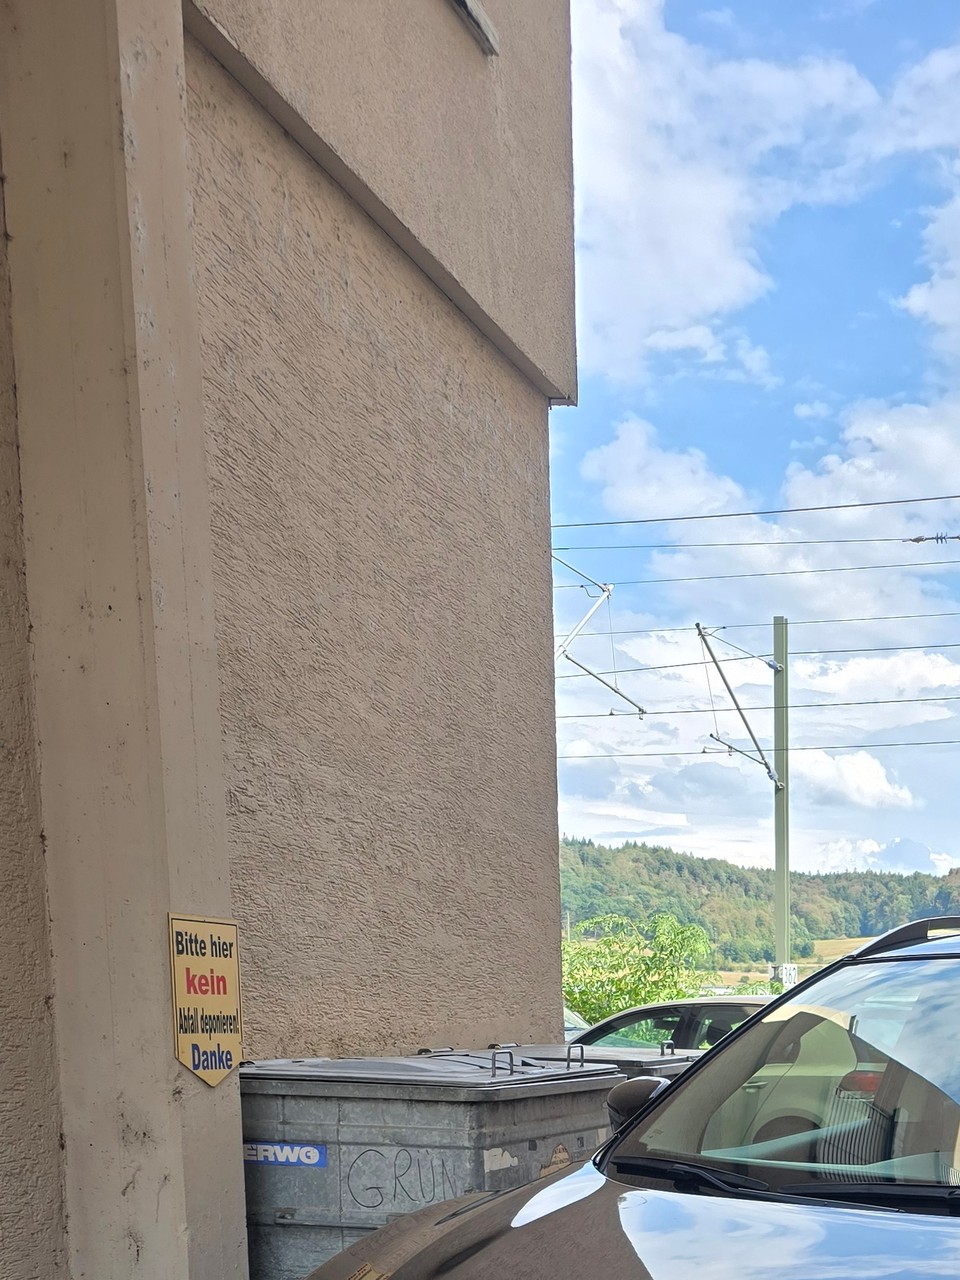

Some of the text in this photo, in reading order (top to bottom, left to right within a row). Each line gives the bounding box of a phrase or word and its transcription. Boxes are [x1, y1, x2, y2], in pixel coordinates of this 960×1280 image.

[174, 930, 234, 959] Bitte hier
[185, 967, 227, 996] kein
[178, 1007, 240, 1041] Abfall deponieren!
[191, 1043, 233, 1071] Danke
[348, 1148, 457, 1208] GRÜN
